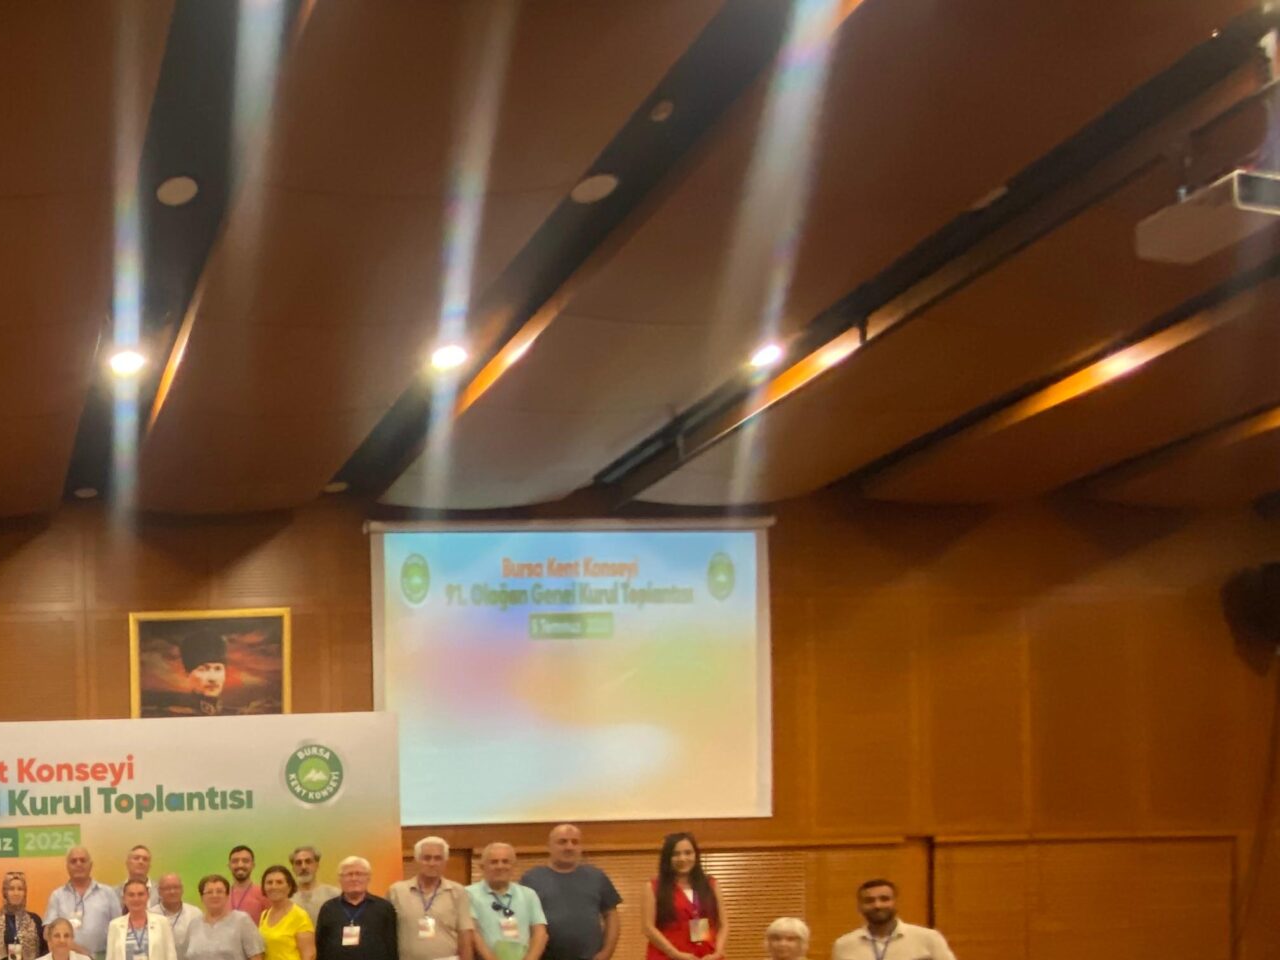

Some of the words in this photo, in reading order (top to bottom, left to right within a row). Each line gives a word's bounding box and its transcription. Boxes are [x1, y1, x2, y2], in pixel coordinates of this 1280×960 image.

[503, 557, 544, 578] Bursa
[548, 556, 580, 577] Kent
[296, 746, 331, 760] BURSA
[17, 754, 135, 787] Konseyi
[8, 786, 91, 816] Kurul
[97, 784, 254, 821] Toplantısı
[24, 831, 75, 851] 2025
